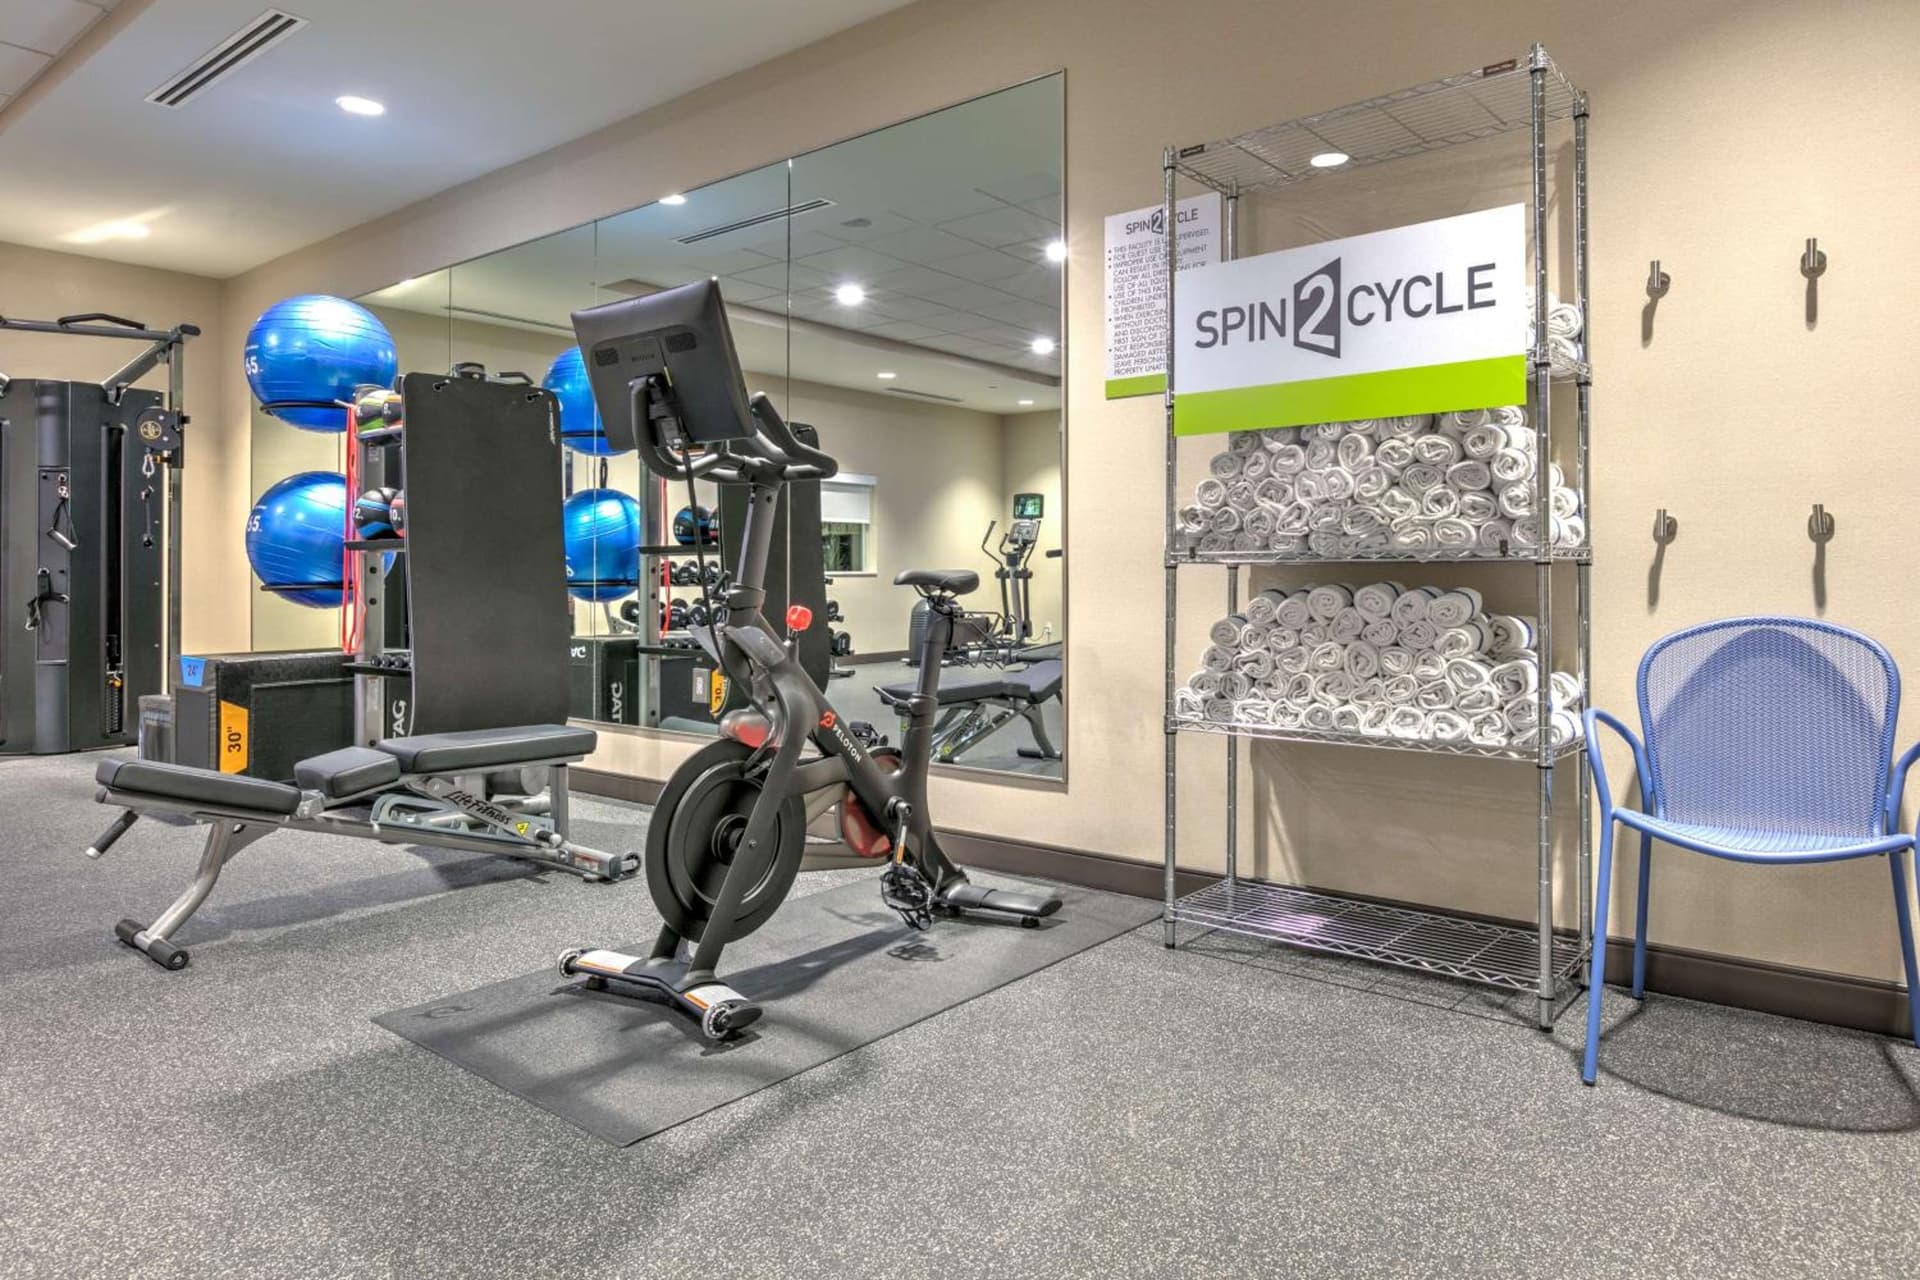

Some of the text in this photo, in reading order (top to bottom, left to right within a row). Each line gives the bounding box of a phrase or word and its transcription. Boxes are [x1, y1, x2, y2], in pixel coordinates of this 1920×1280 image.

[1126, 219, 1150, 235] SPIN
[1194, 262, 1497, 351] SPIN 2 CYCLE
[227, 726, 242, 753] 30"
